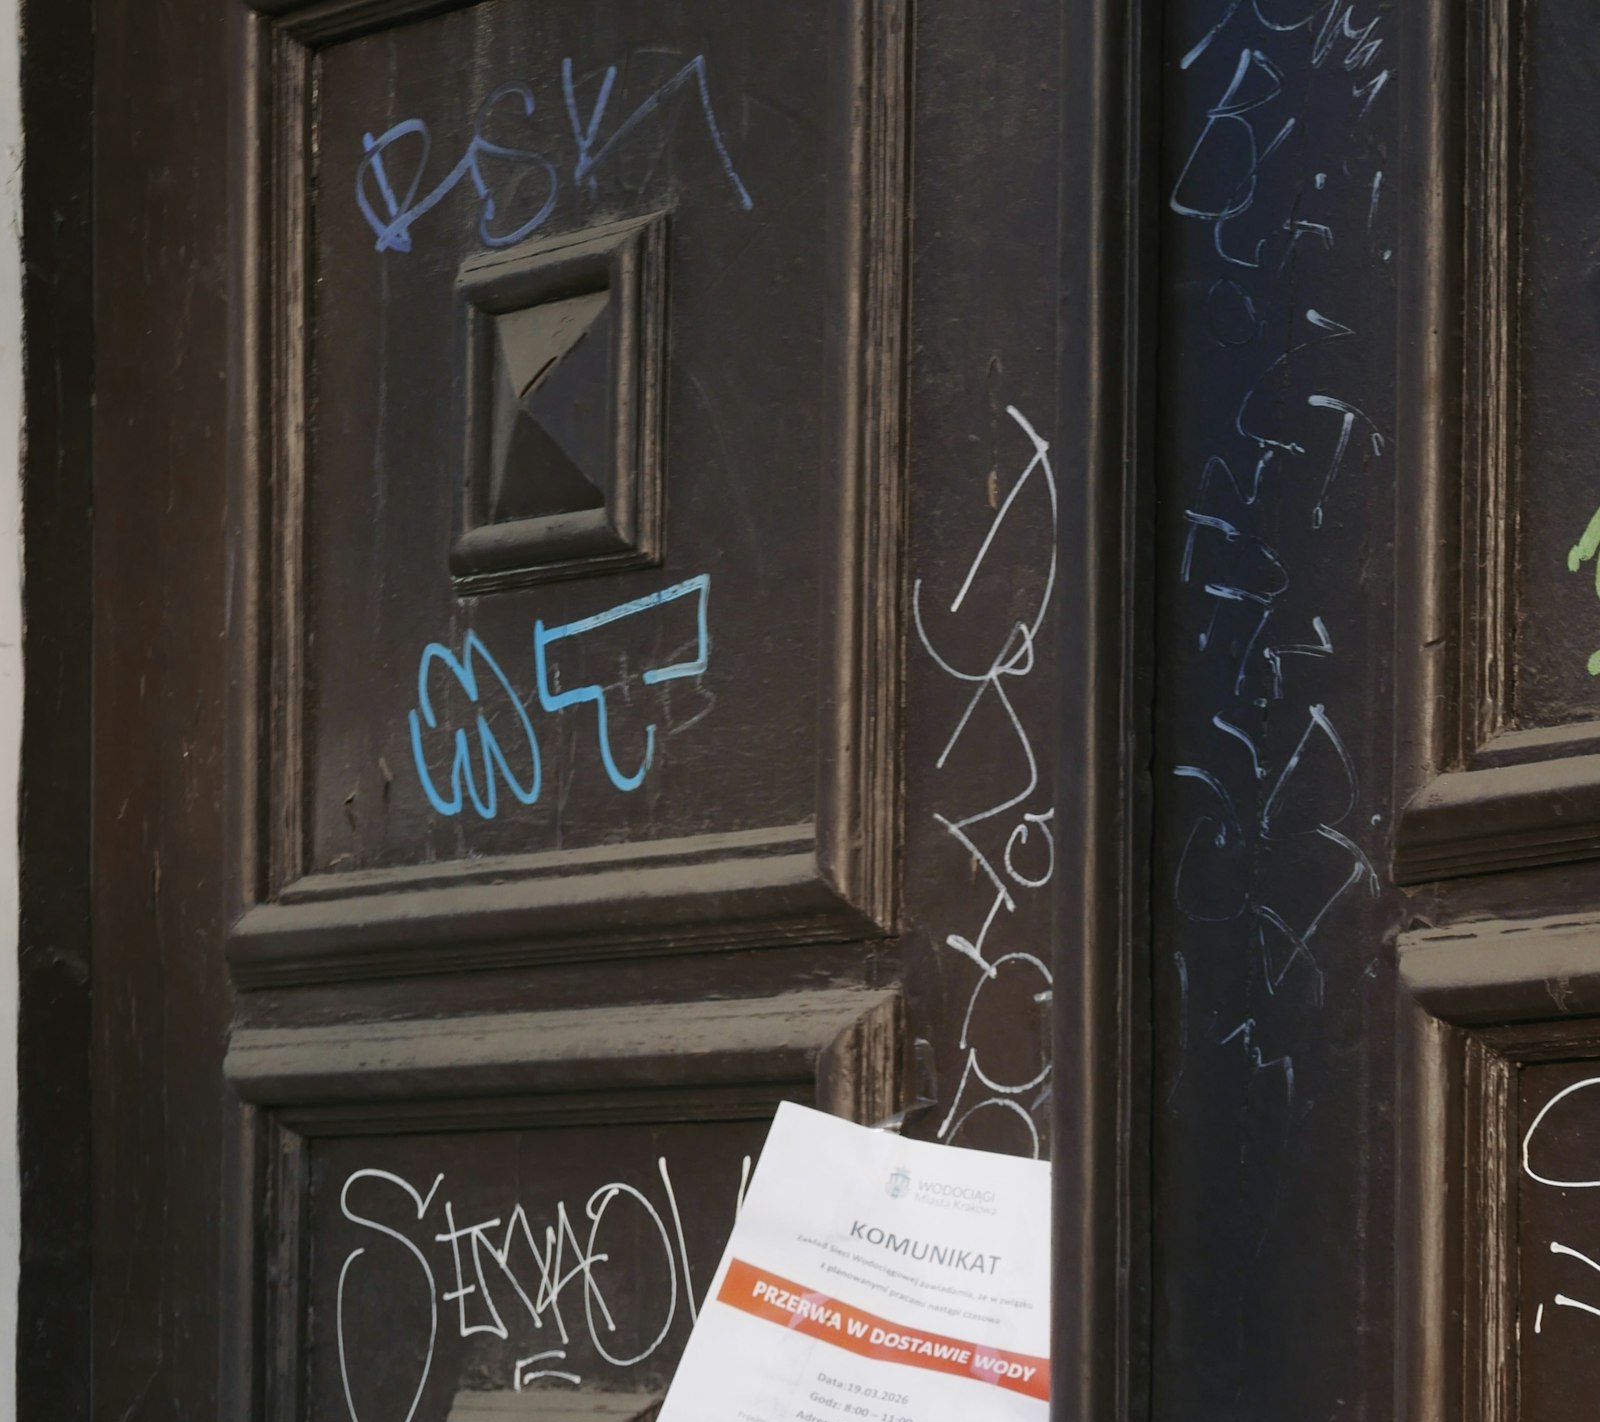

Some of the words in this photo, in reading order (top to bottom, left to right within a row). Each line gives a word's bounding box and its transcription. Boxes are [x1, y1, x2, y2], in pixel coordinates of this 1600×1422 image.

[914, 1193, 951, 1210] Miasta
[952, 1200, 998, 1216] Krakowa
[919, 1180, 996, 1204] WODOCIĄGI
[851, 1219, 1002, 1275] KOMUNIKAT
[827, 1264, 889, 1294] planowanymi
[889, 1289, 926, 1310] pracami
[752, 1281, 842, 1330] PRZERWA
[847, 1318, 869, 1338] W
[869, 1328, 971, 1365] DOSTAWIE
[974, 1354, 1037, 1383] WODY
[809, 1391, 843, 1410] Godz:
[843, 1403, 869, 1418] 8:00
[817, 1372, 910, 1405] Data:19.03.2026
